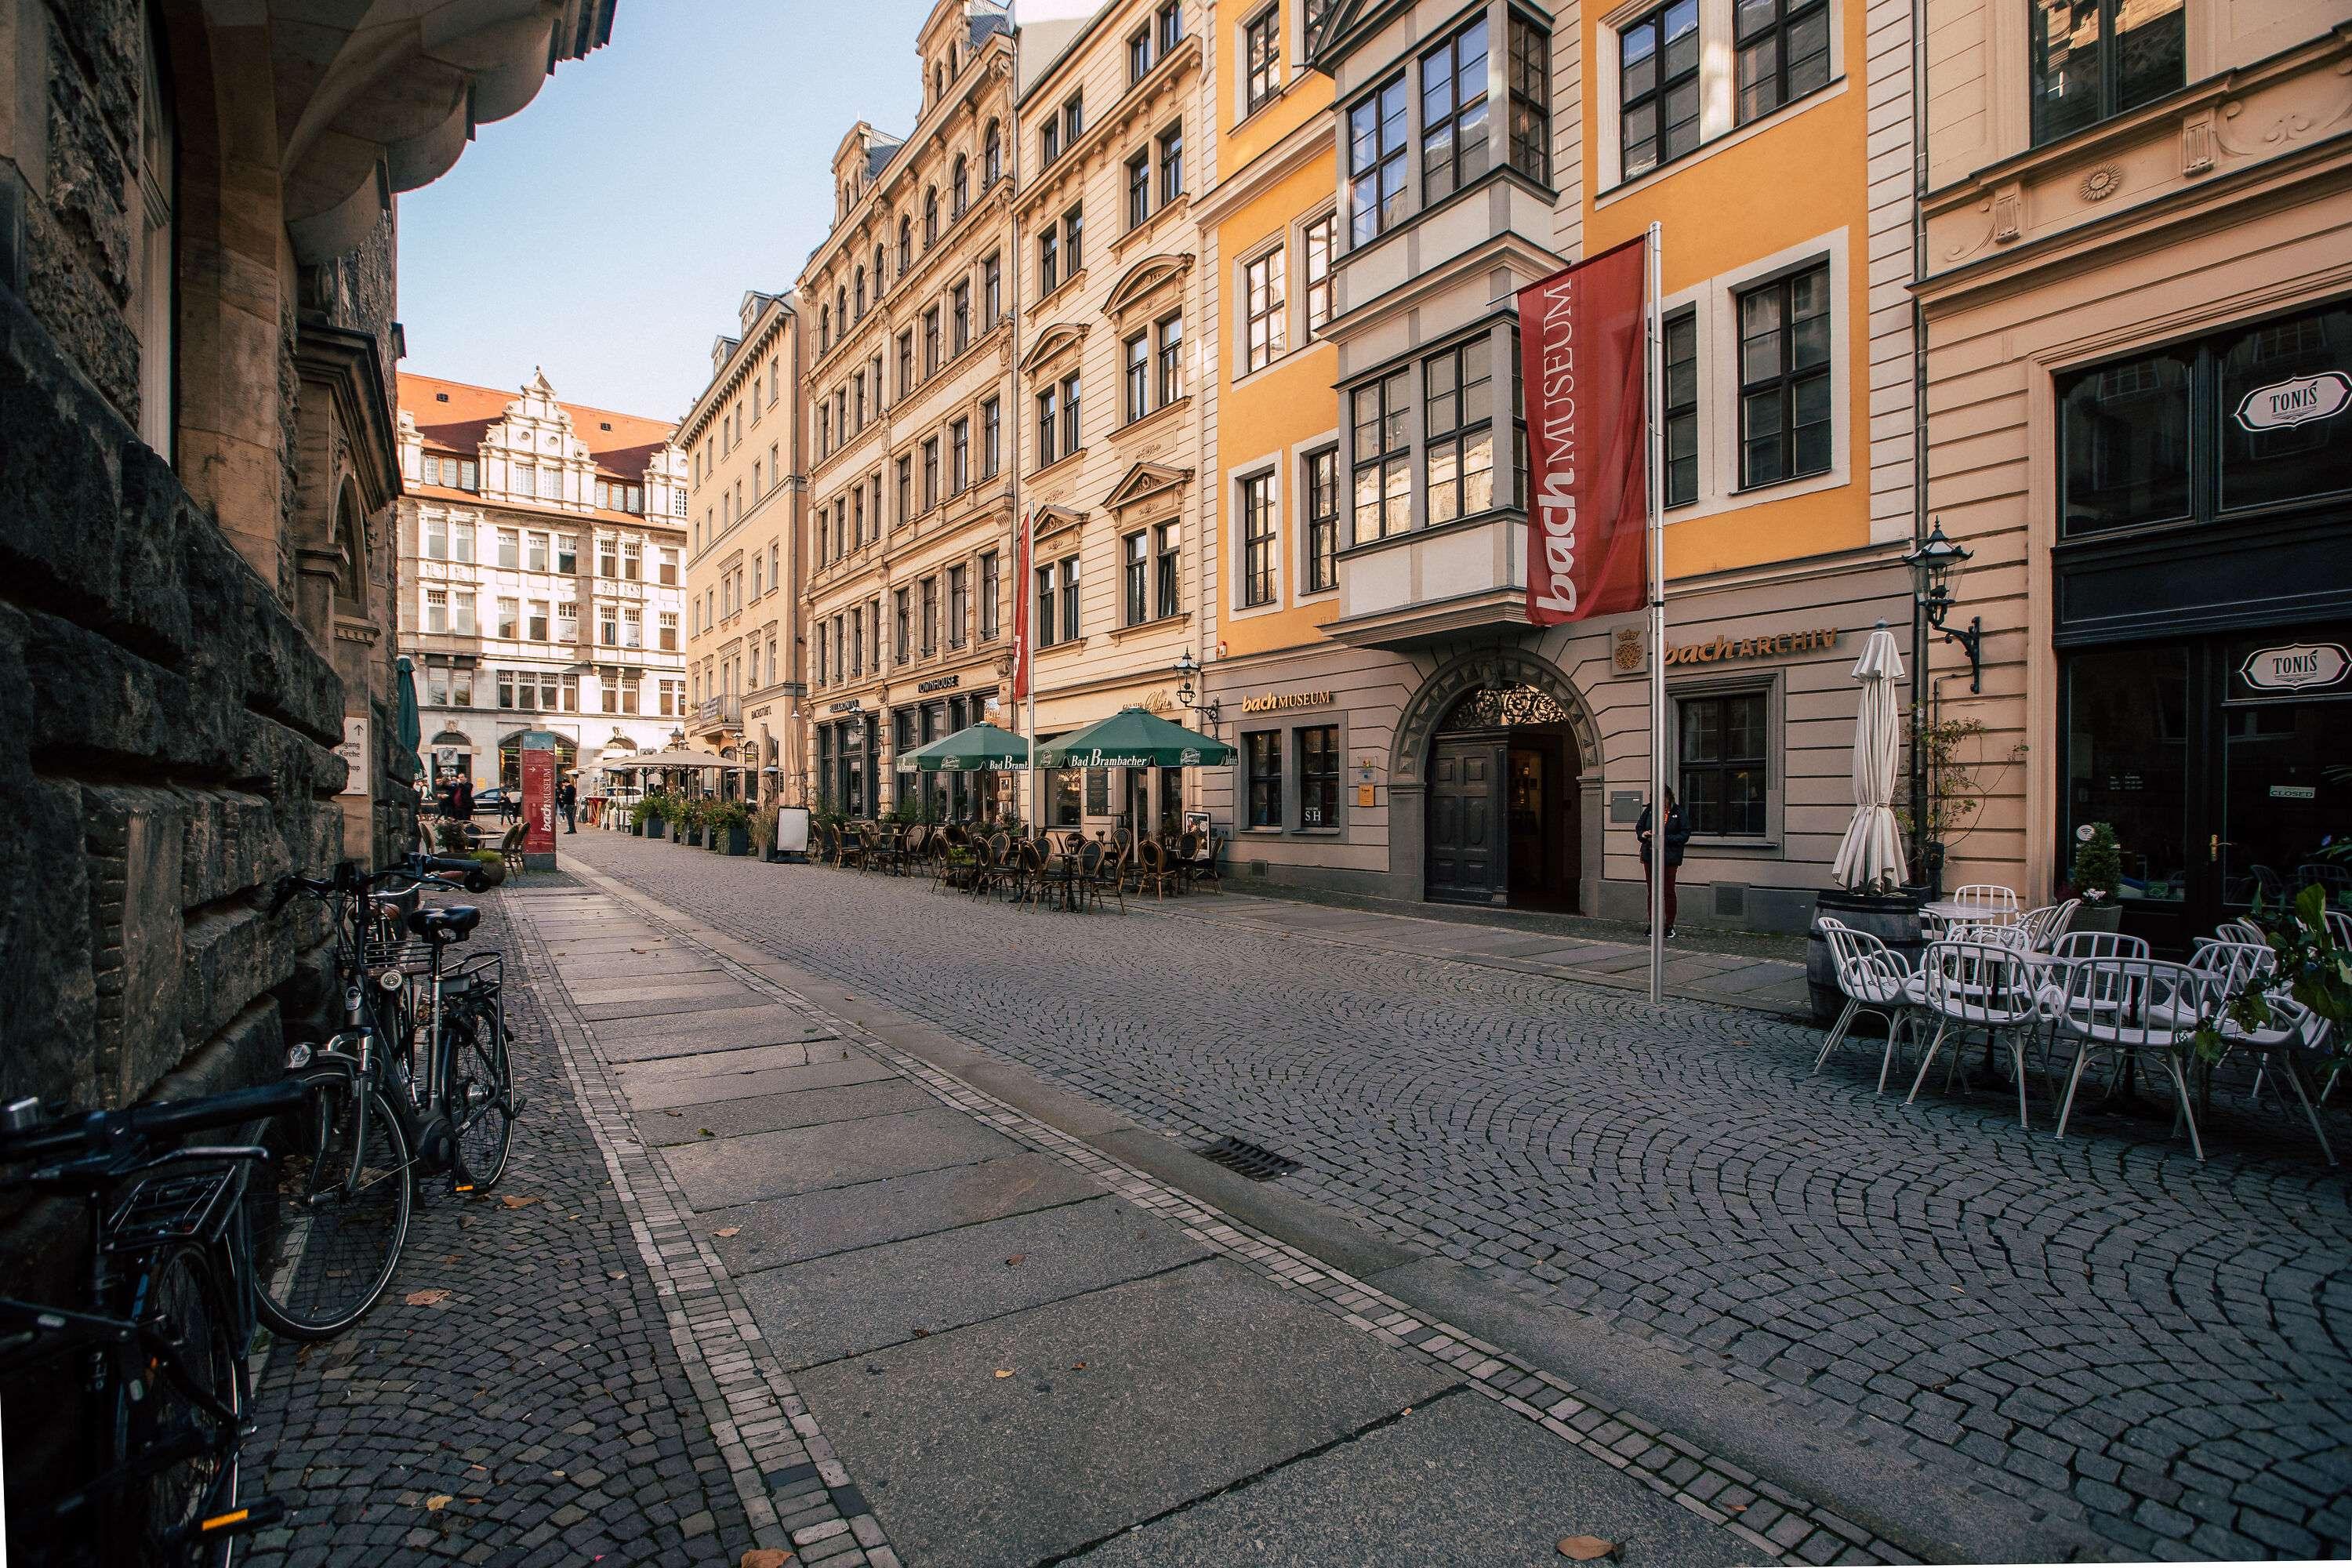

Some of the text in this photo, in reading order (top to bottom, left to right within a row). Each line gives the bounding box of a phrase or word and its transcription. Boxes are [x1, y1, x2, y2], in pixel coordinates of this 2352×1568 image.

[989, 760, 1003, 769] Bad
[1071, 755, 1088, 767] Bad
[1089, 748, 1147, 767] Brambacher
